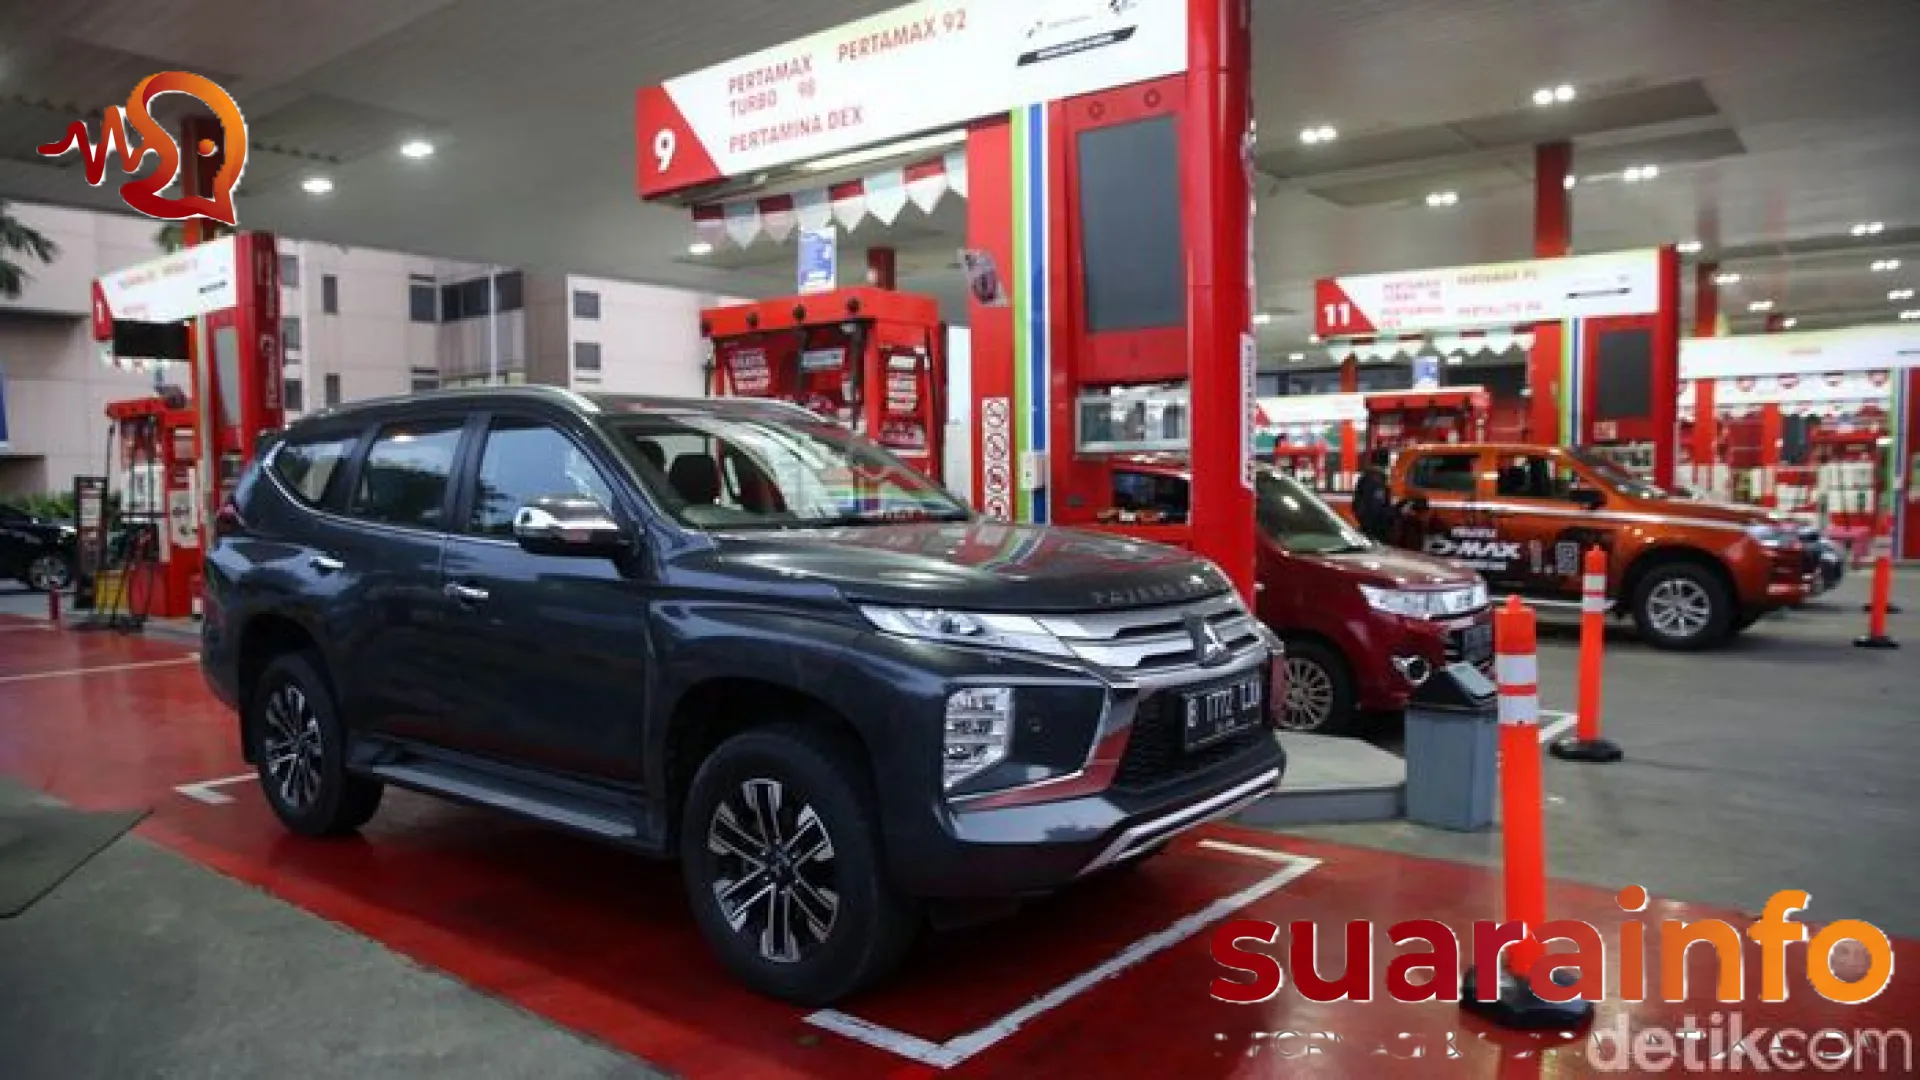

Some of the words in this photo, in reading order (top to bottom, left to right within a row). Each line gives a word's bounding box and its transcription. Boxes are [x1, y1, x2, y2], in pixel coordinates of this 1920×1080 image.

[837, 15, 937, 64] PERTAMAX
[942, 7, 968, 34] 92
[727, 53, 813, 95] PERTAMAX
[728, 88, 778, 119] TURBO
[653, 128, 676, 172] 9
[728, 113, 824, 154] PERTAMINA
[827, 105, 865, 131] DEX
[1323, 303, 1351, 327] 11
